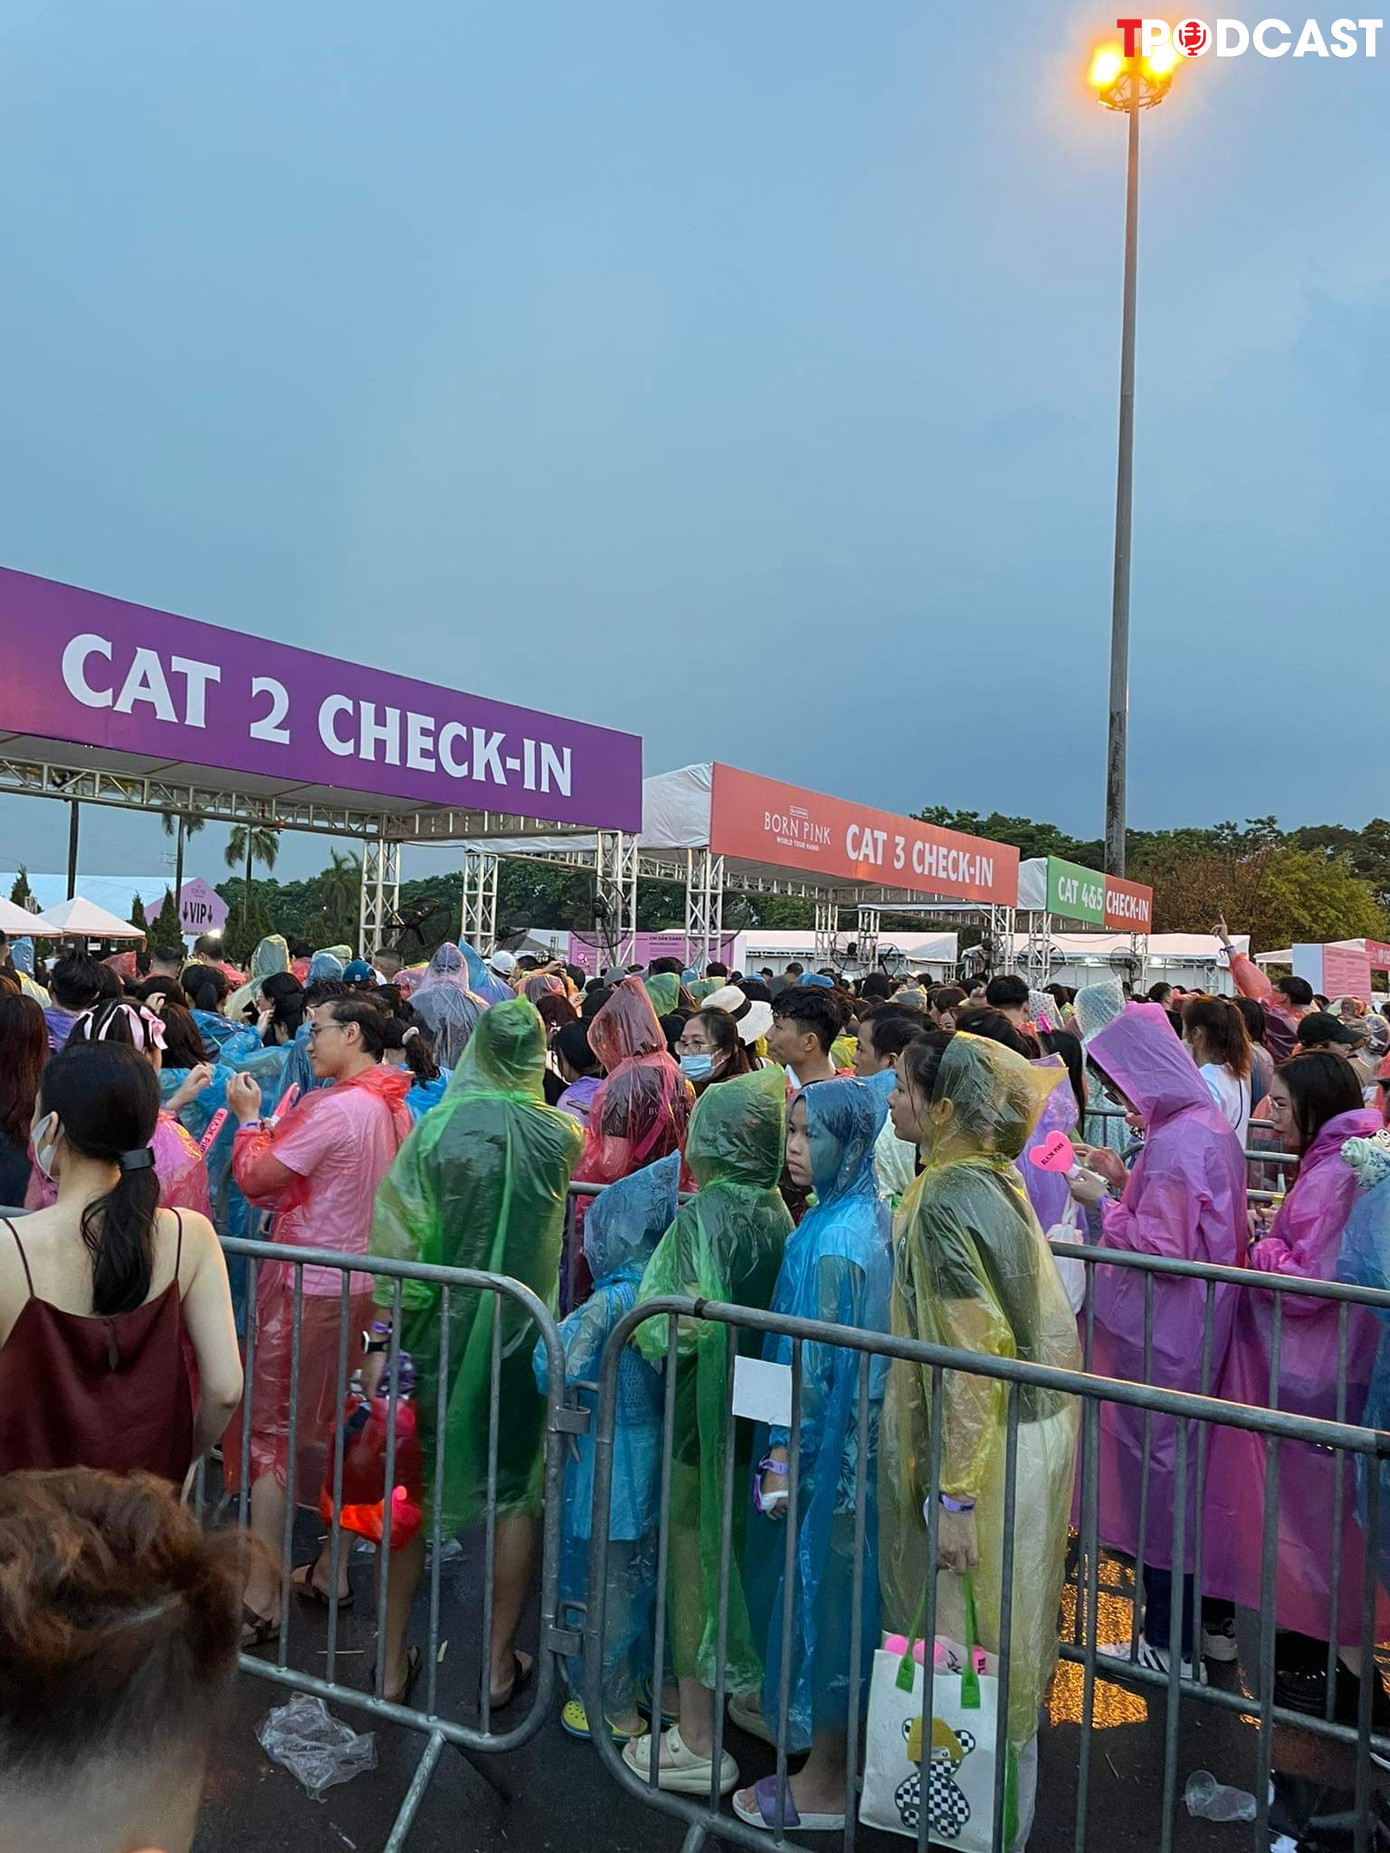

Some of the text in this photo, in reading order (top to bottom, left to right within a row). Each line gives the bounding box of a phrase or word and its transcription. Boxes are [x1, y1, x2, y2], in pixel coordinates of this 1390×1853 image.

[61, 633, 572, 797] CAT 2 CHECK-IN
[764, 811, 832, 845] BORN PINK
[845, 823, 994, 888] CAT 3 CHECK-IN
[189, 901, 208, 924] VIP
[1057, 875, 1150, 922] CAT 4&5 CHECK-IN
